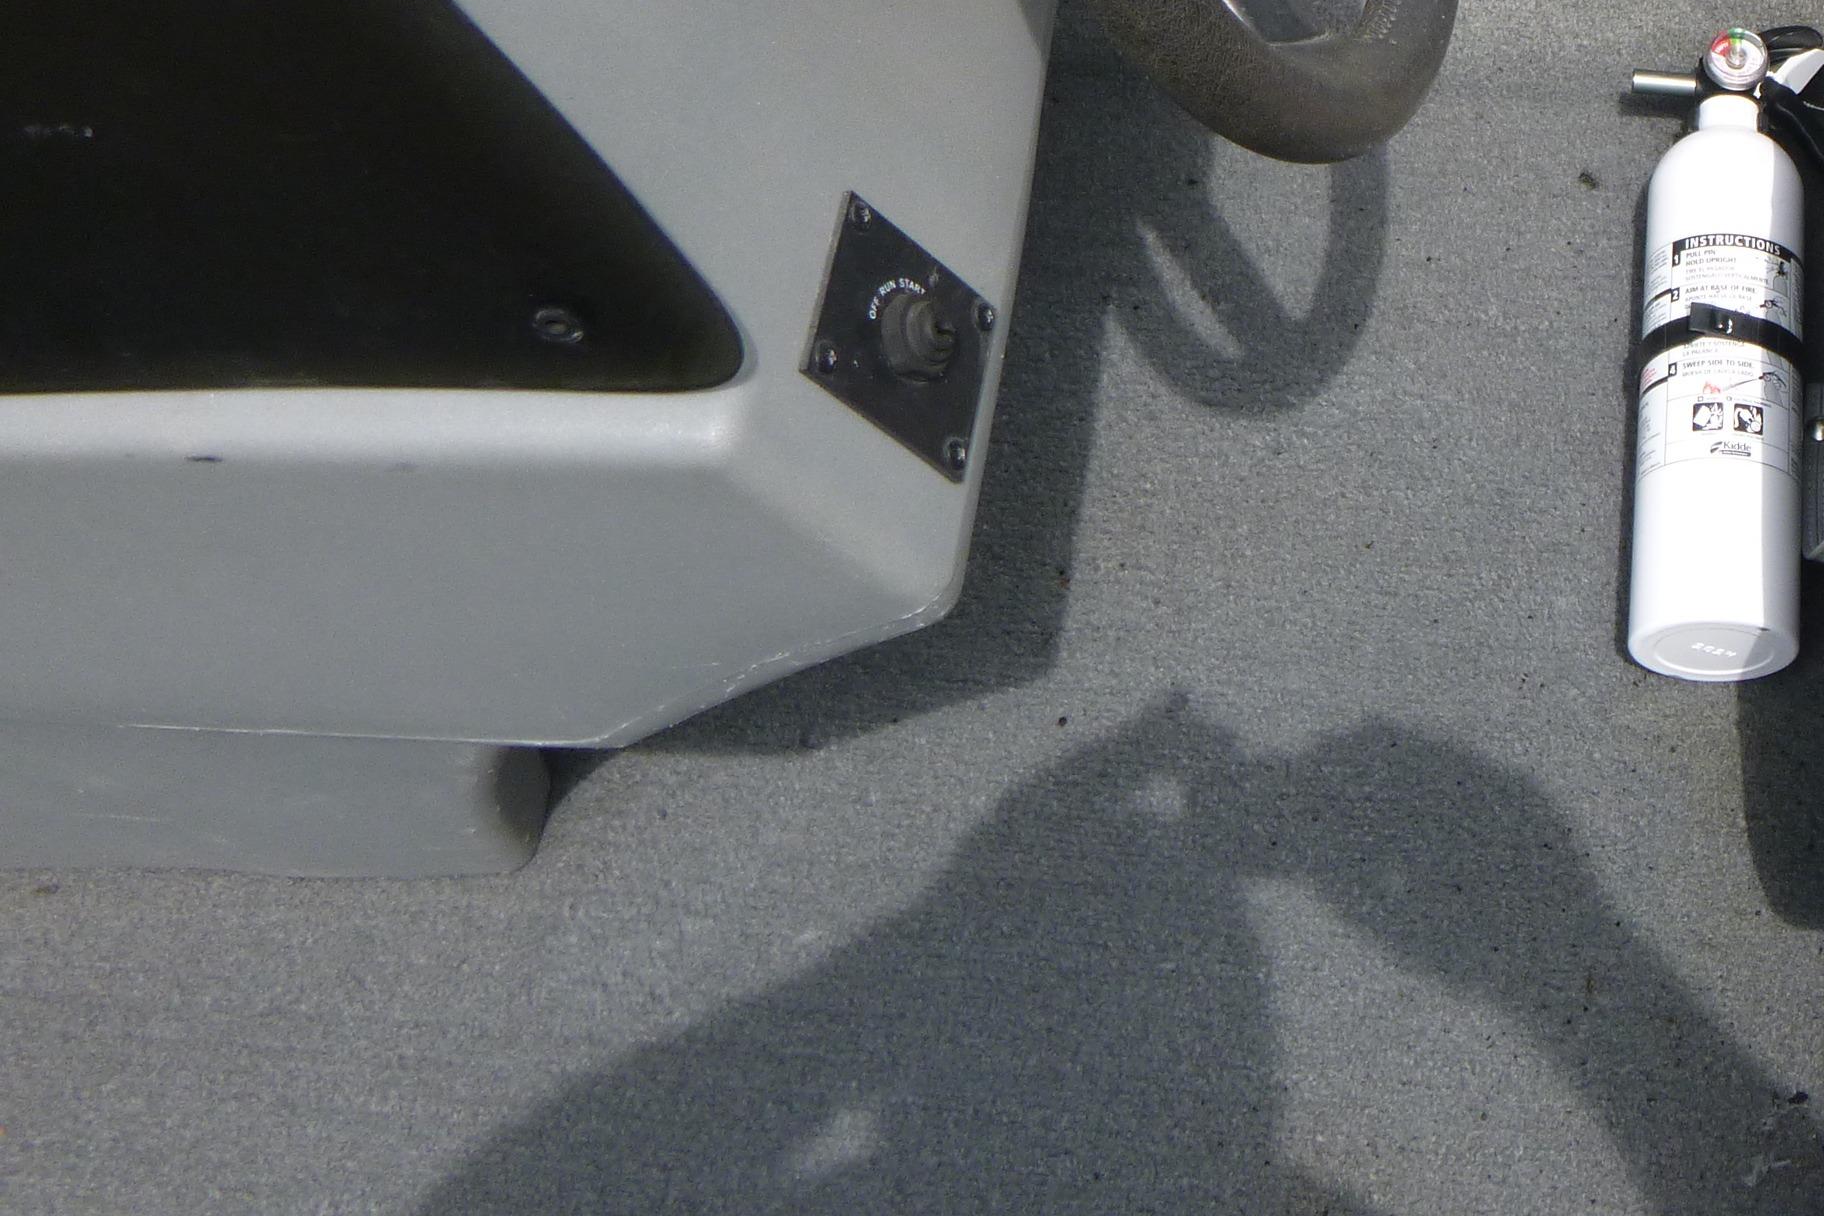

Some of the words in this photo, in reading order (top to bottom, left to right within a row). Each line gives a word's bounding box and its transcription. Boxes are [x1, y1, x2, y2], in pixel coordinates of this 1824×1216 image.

[1685, 234, 1780, 256] INSTRUCTIONS
[1686, 250, 1701, 258] PULL
[880, 280, 896, 296] RUN
[899, 278, 926, 294] START
[1673, 290, 1678, 300] 2
[870, 296, 880, 320] OFF
[1682, 360, 1705, 368] SWEEP
[1670, 366, 1676, 374] 4
[1723, 442, 1752, 452] Kidde
